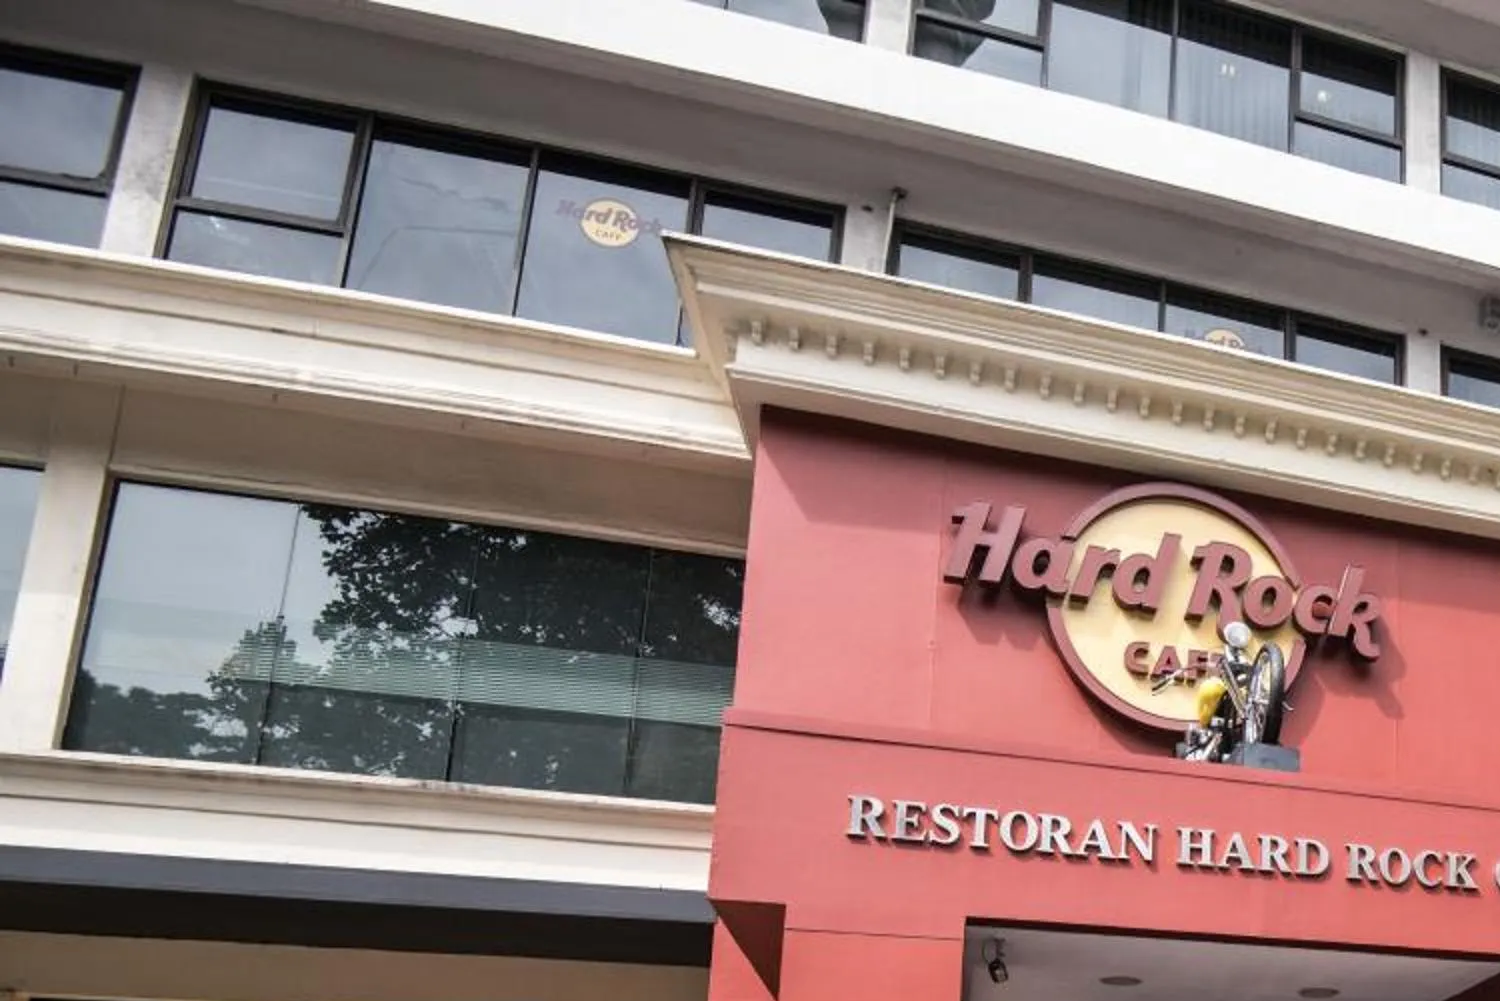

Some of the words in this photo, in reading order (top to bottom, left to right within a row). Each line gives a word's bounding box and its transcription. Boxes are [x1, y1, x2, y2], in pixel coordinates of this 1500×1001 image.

[943, 500, 1182, 615] Hard
[1184, 541, 1383, 662] Rock
[847, 794, 1158, 866] RESTORAN
[1176, 826, 1331, 878] HARD
[1346, 842, 1480, 891] ROCK
